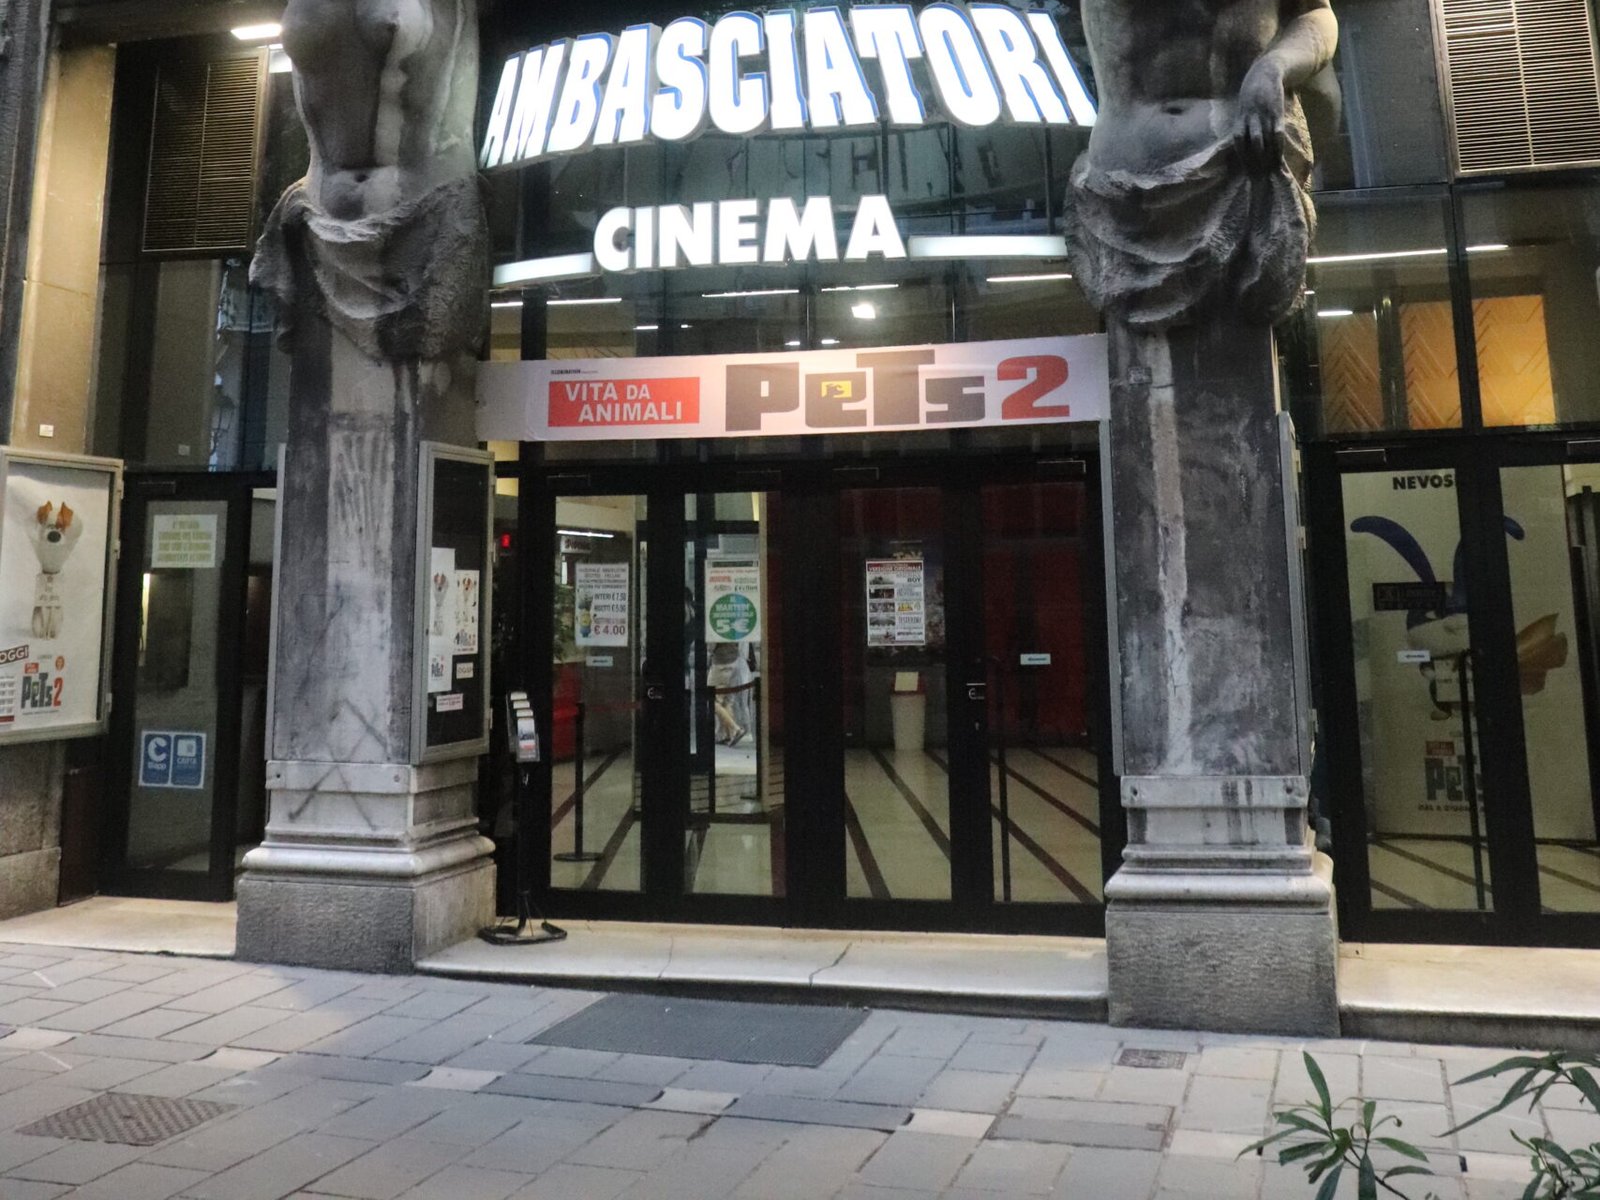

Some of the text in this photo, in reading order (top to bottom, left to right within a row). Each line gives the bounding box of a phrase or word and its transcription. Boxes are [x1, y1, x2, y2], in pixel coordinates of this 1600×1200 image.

[479, 3, 1098, 168] AMBASCIATORI
[593, 195, 906, 271] CINEMA
[565, 382, 650, 401] VITA DA
[997, 354, 1070, 420] 2
[578, 401, 682, 422] ANIMALI
[53, 677, 63, 707] 2
